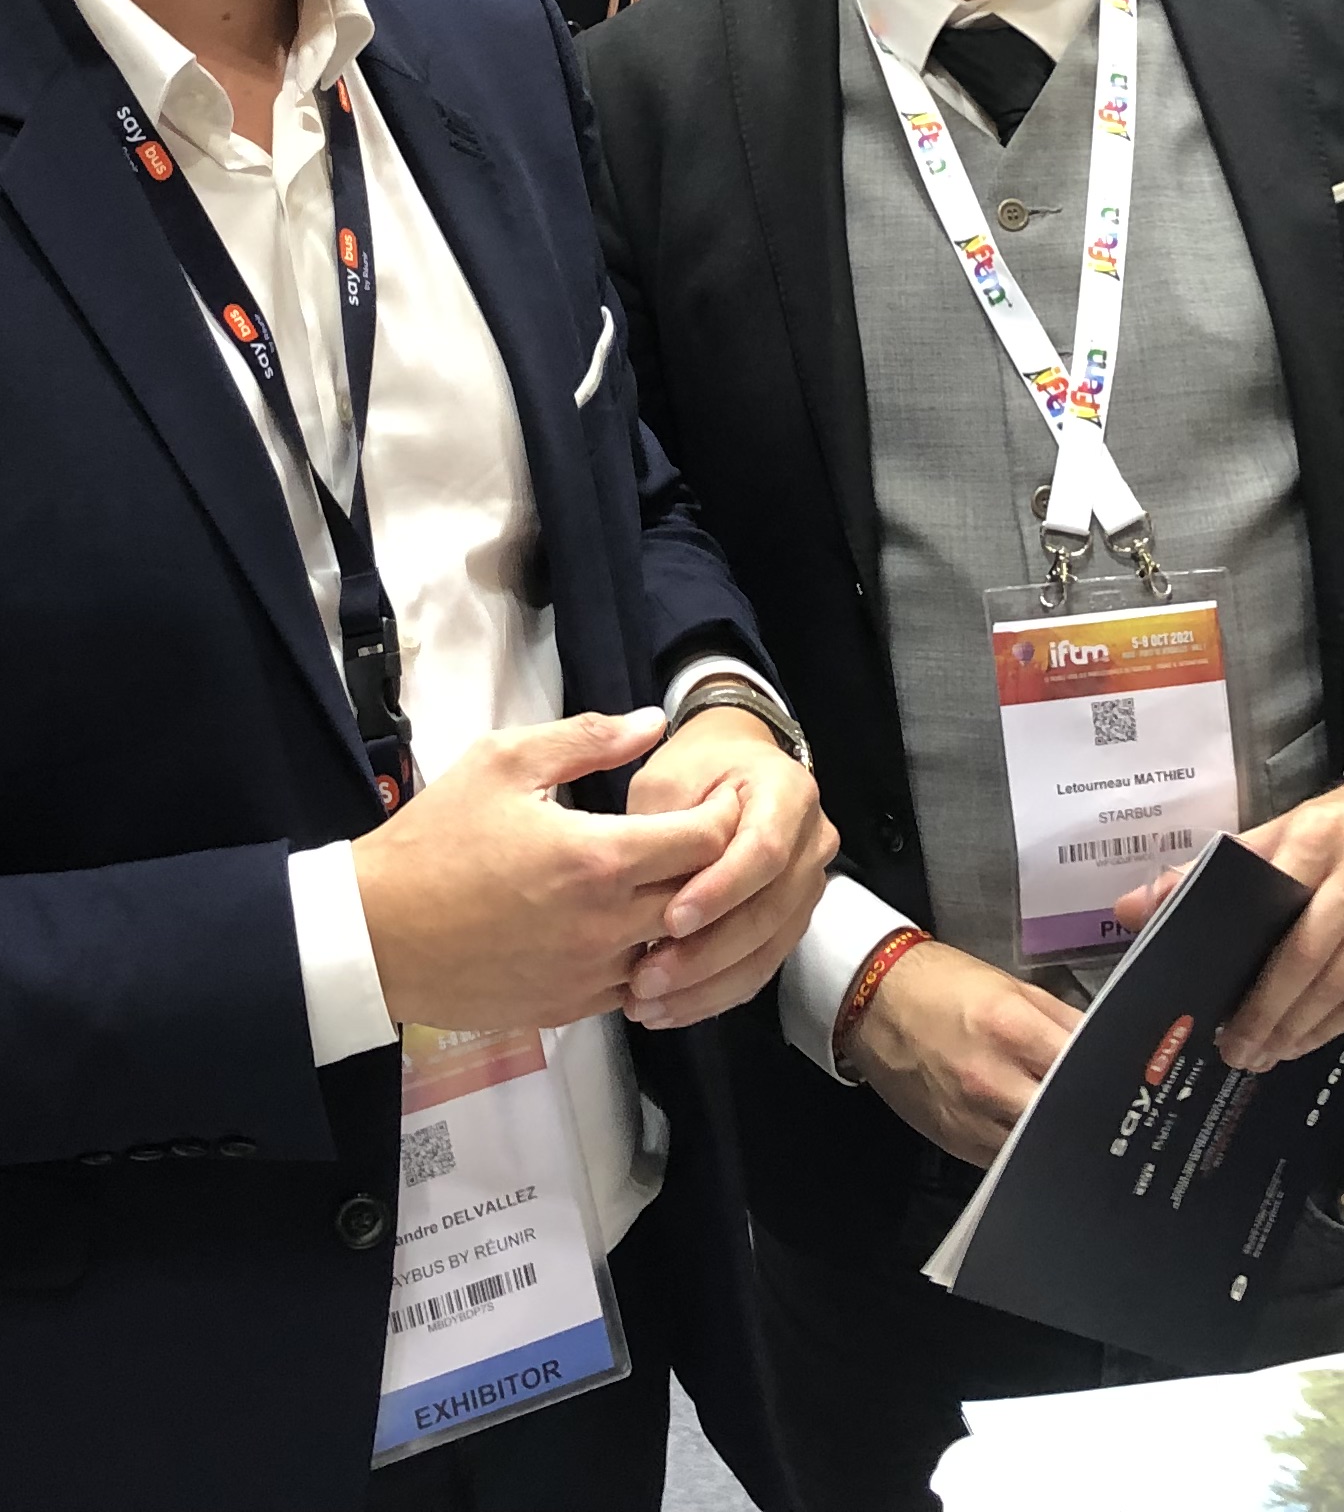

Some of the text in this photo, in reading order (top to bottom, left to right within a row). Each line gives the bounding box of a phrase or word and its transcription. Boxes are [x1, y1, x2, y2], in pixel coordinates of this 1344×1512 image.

[116, 105, 147, 143] say
[144, 144, 167, 176] bus
[344, 234, 361, 307] say bus
[954, 234, 1007, 308] iftm
[229, 308, 274, 380] say bus
[1023, 366, 1070, 432] ift
[1070, 348, 1108, 430] iftm
[1049, 639, 1111, 669] iftm
[1170, 630, 1194, 645] 2021
[1056, 767, 1196, 796] Letourneau MATHIEU
[1098, 804, 1163, 824] STARBUS
[395, 1185, 539, 1248] andre DELVALLEZ
[391, 1226, 537, 1289] AYBUS BY RÉUNIR
[414, 1359, 563, 1431] EXHIBITOR
